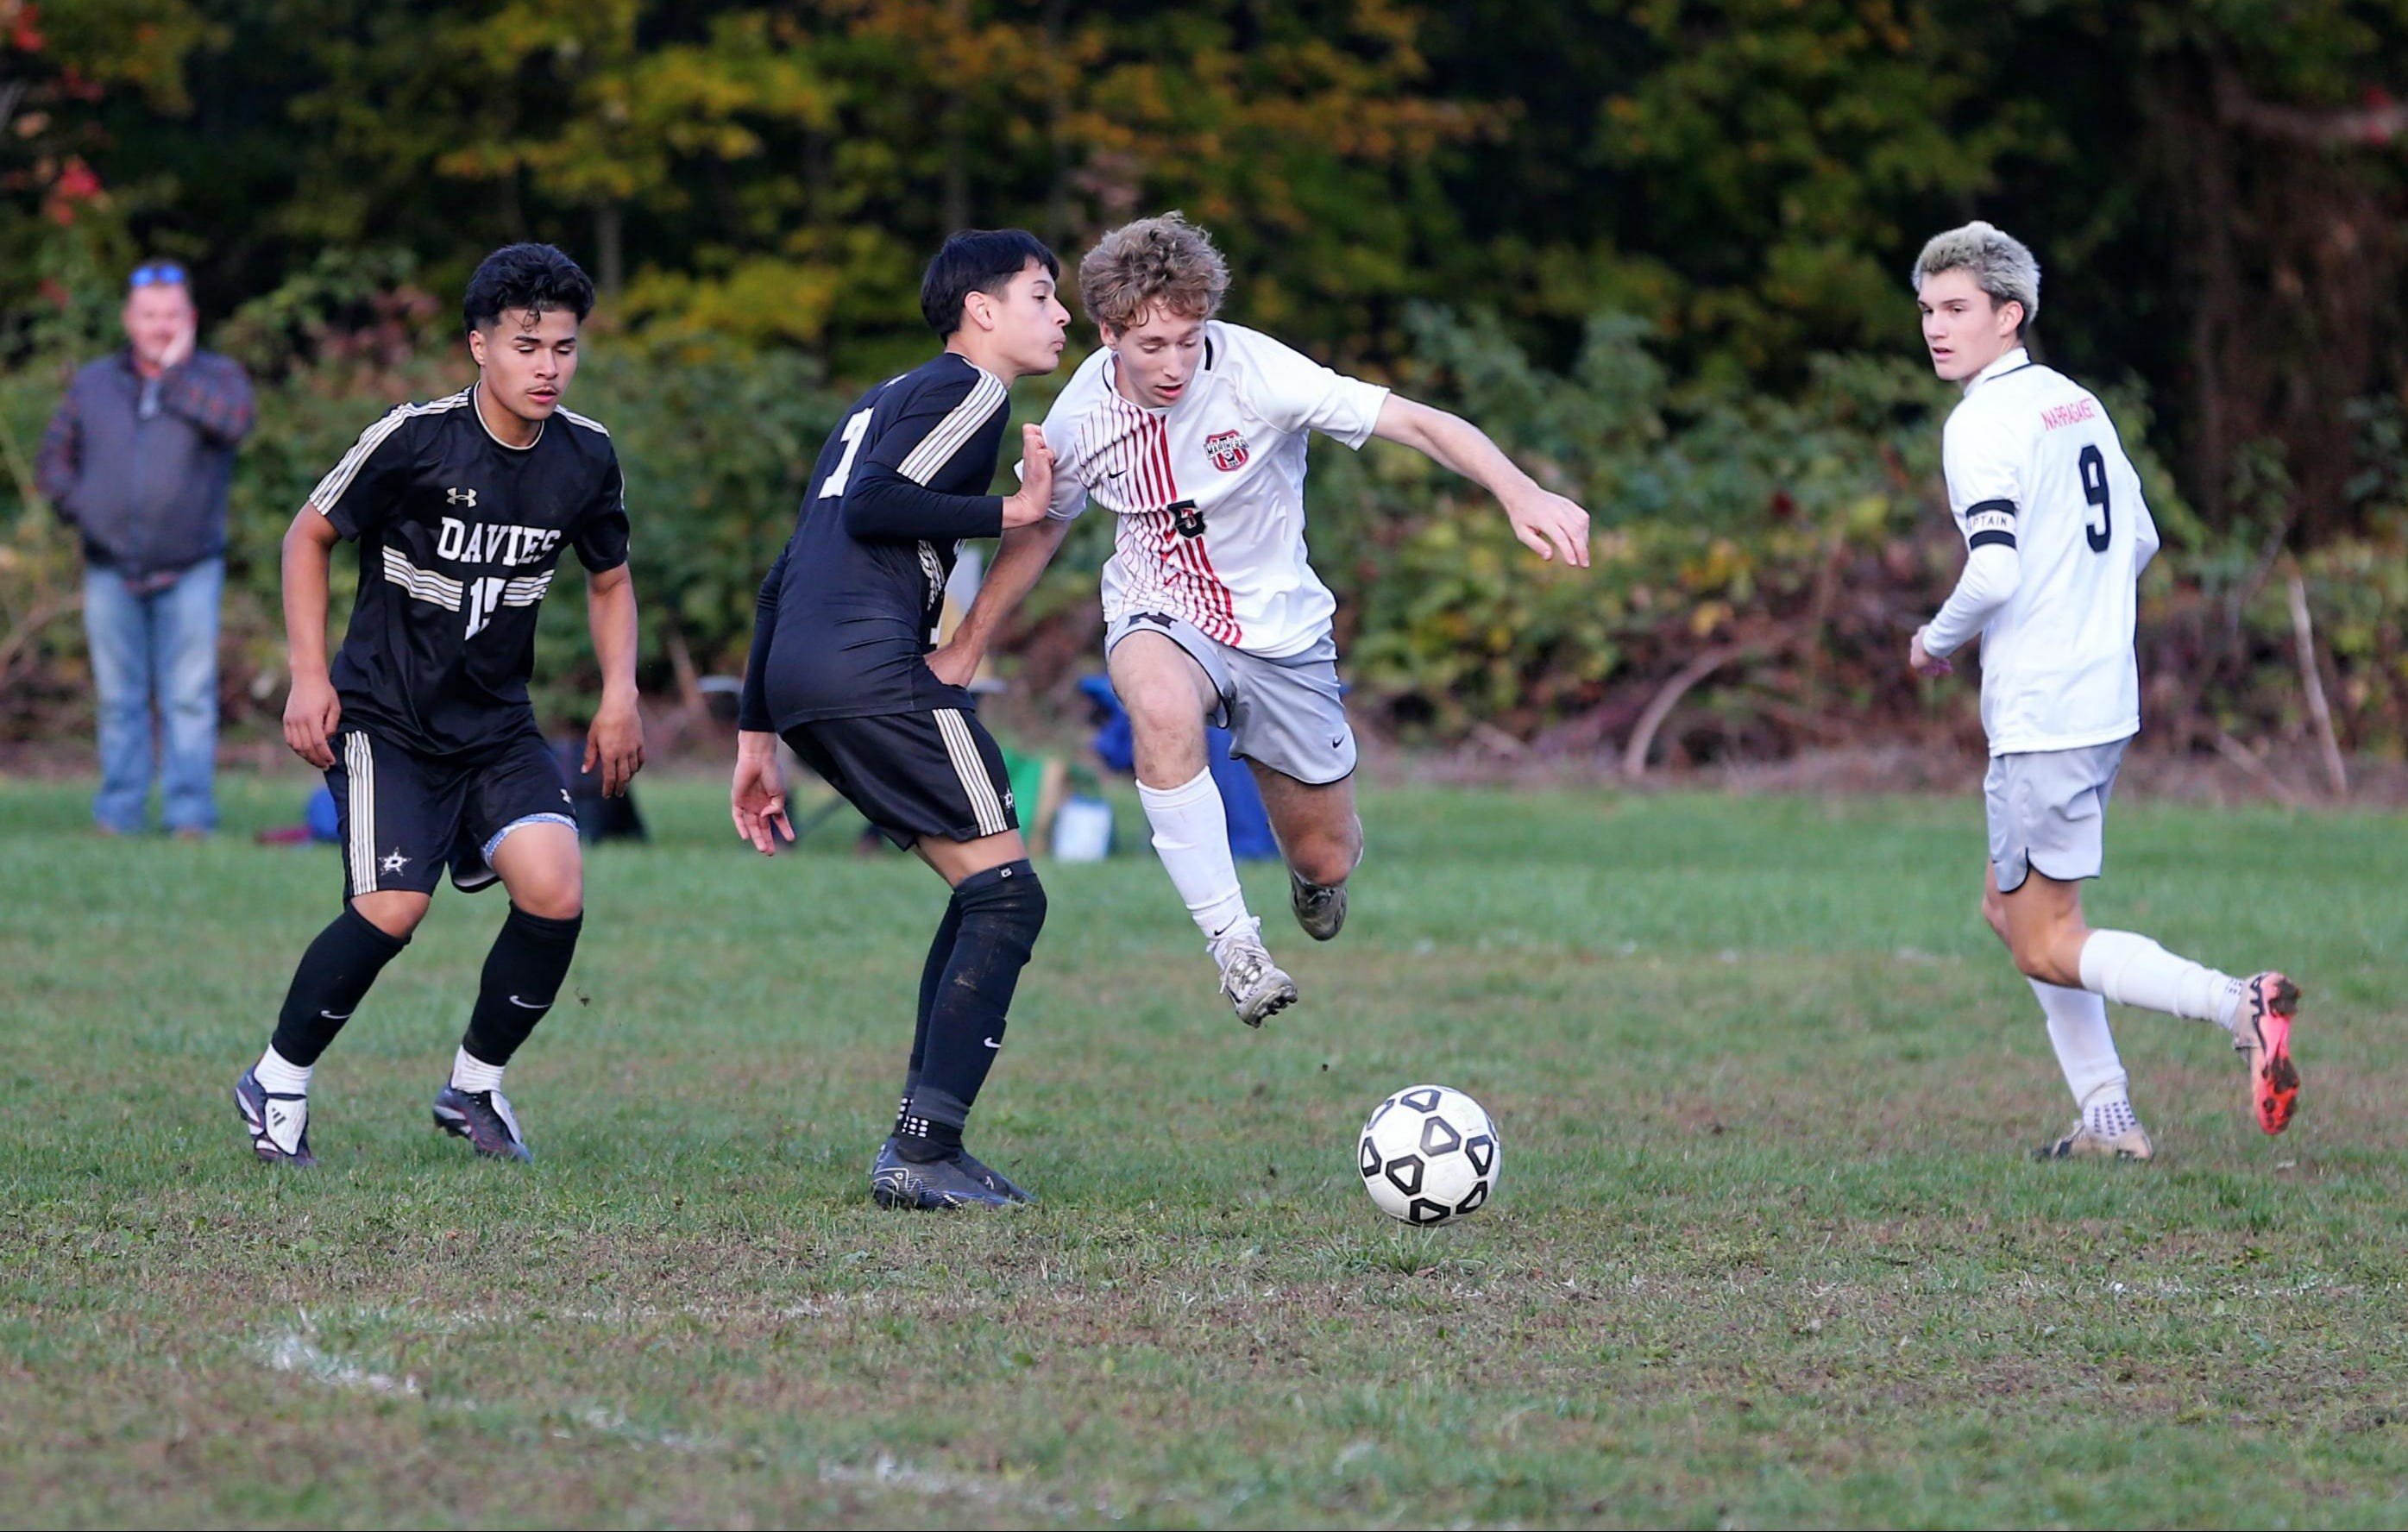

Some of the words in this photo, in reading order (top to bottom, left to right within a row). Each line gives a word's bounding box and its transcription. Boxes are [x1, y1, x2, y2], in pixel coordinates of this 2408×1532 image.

[1167, 499, 1205, 538] 5
[2078, 444, 2111, 553] 9
[437, 516, 562, 567] DAVIES
